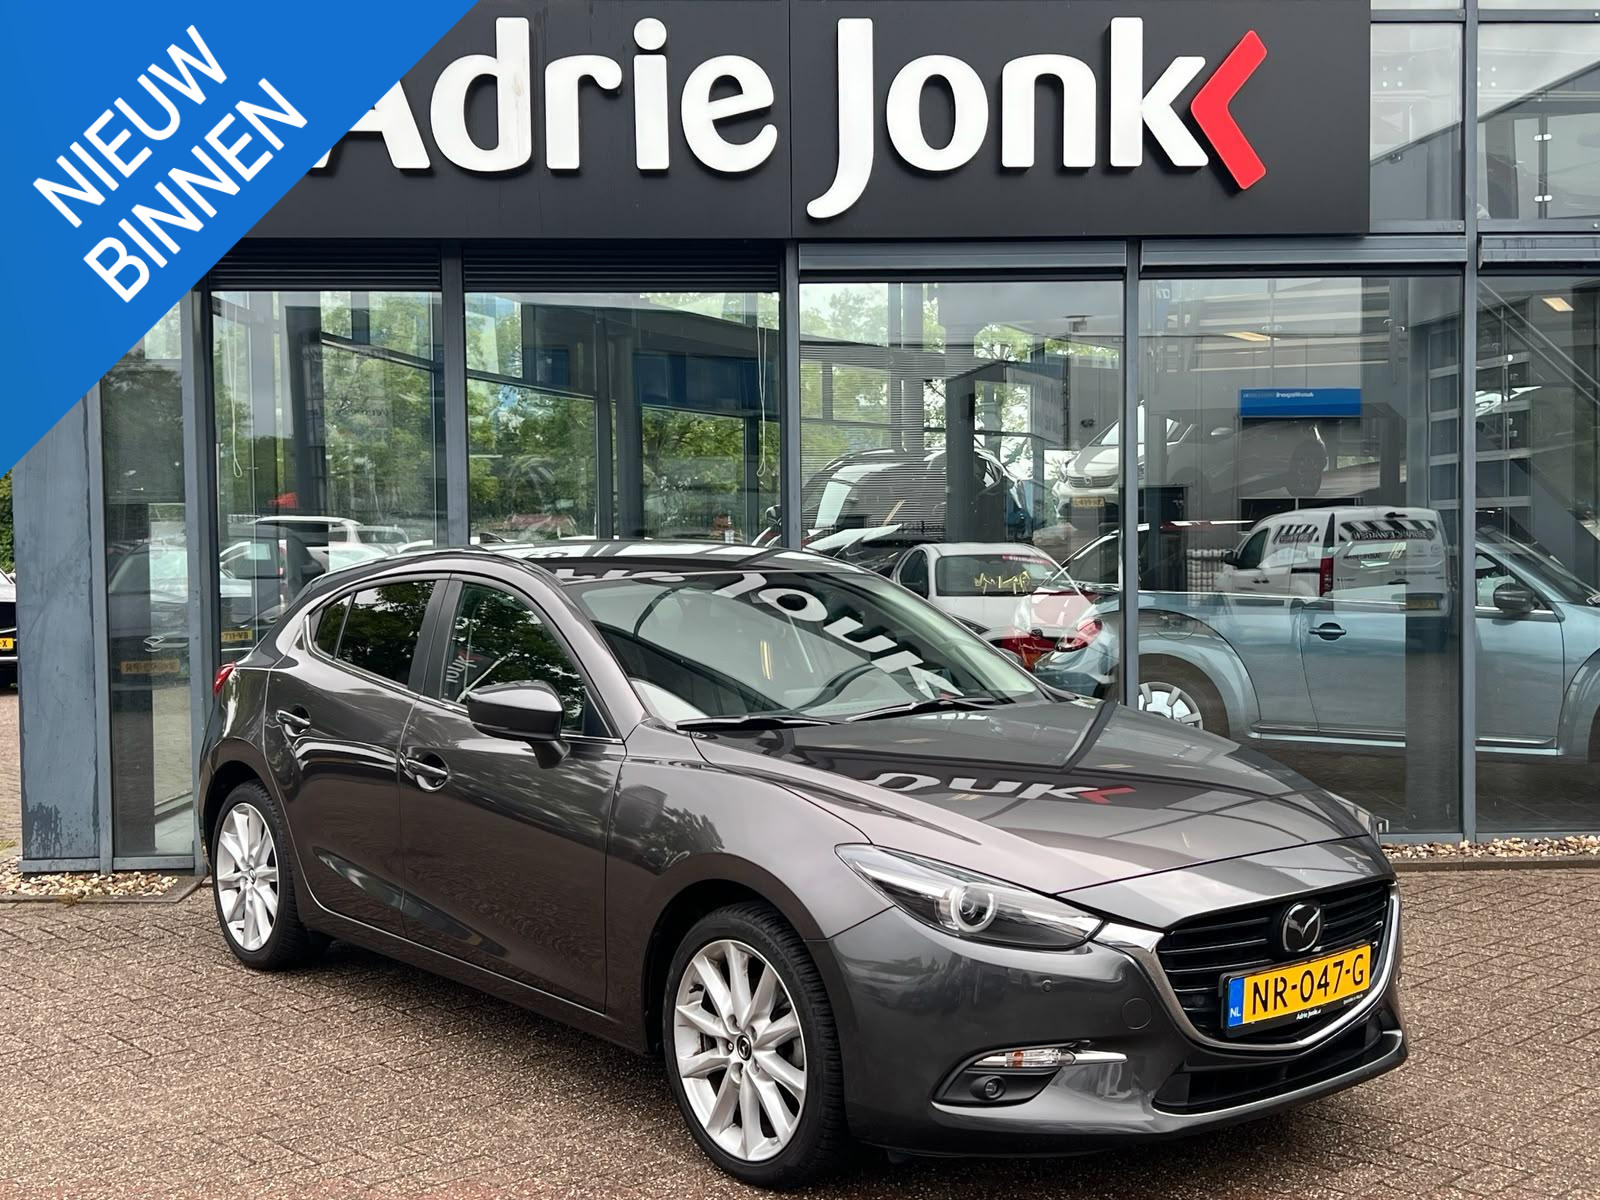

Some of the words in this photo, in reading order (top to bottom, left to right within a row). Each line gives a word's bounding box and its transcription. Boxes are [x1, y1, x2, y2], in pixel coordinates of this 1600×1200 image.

[807, 18, 1209, 218] Jonk
[1230, 1006, 1241, 1018] NL
[1252, 953, 1364, 1015] NR-047-G
